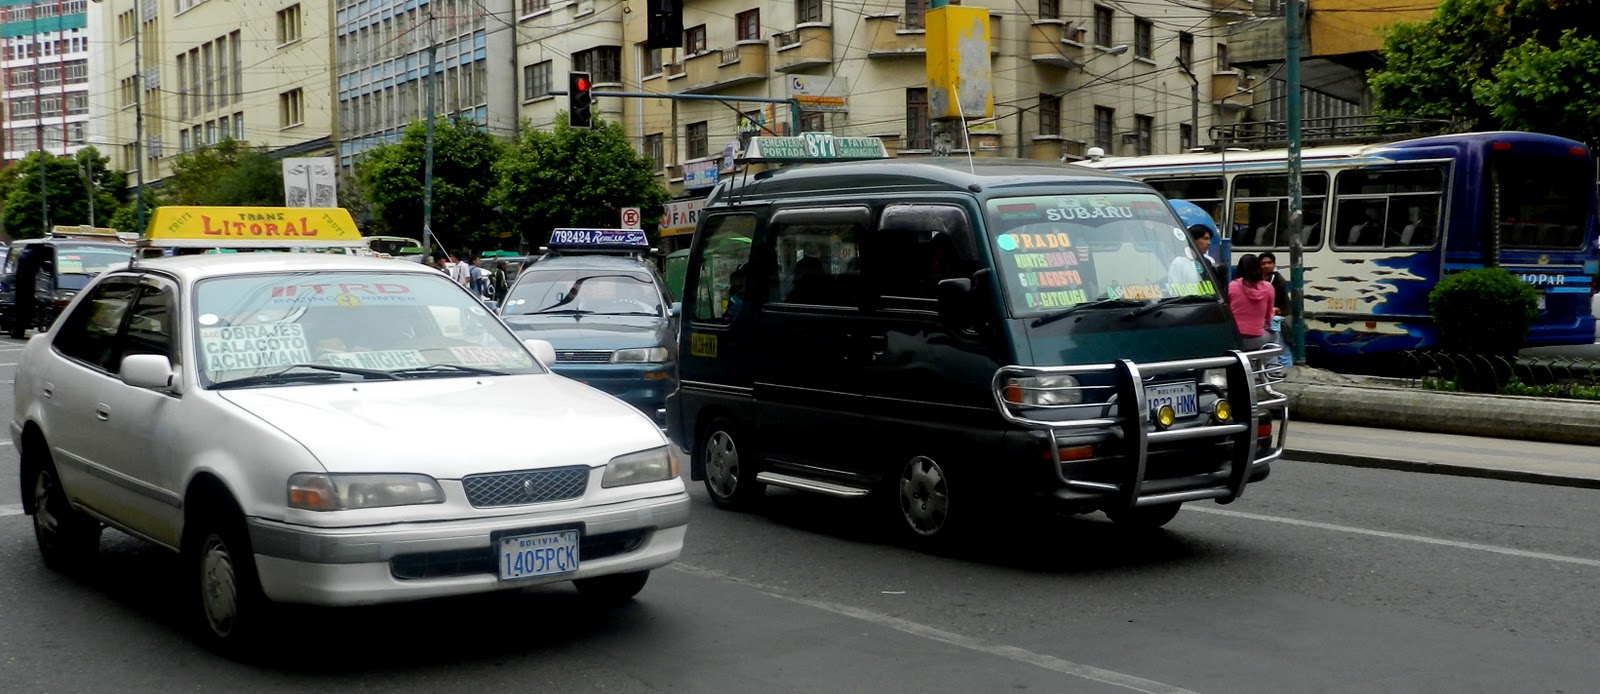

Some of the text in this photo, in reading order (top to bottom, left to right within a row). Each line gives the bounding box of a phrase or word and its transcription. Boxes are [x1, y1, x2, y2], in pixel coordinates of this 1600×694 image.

[806, 133, 836, 157] 877
[848, 138, 878, 147] FATIMA
[763, 147, 806, 157] PORTADA
[238, 213, 285, 221] TRANS
[1046, 206, 1133, 221] SUBARU
[201, 215, 318, 236] LITORAL
[555, 230, 591, 243] 792424
[1011, 232, 1071, 248] PRADO
[1018, 272, 1028, 287] 6
[1038, 270, 1082, 286] AGOSTO
[221, 324, 301, 340] OBRAJES
[206, 337, 305, 354] CALACOTO
[211, 349, 311, 369] ACHUMANI
[1158, 387, 1184, 395] BOLIVIA
[520, 537, 559, 547] BOLIVIA
[505, 545, 576, 576] 1405PCK
